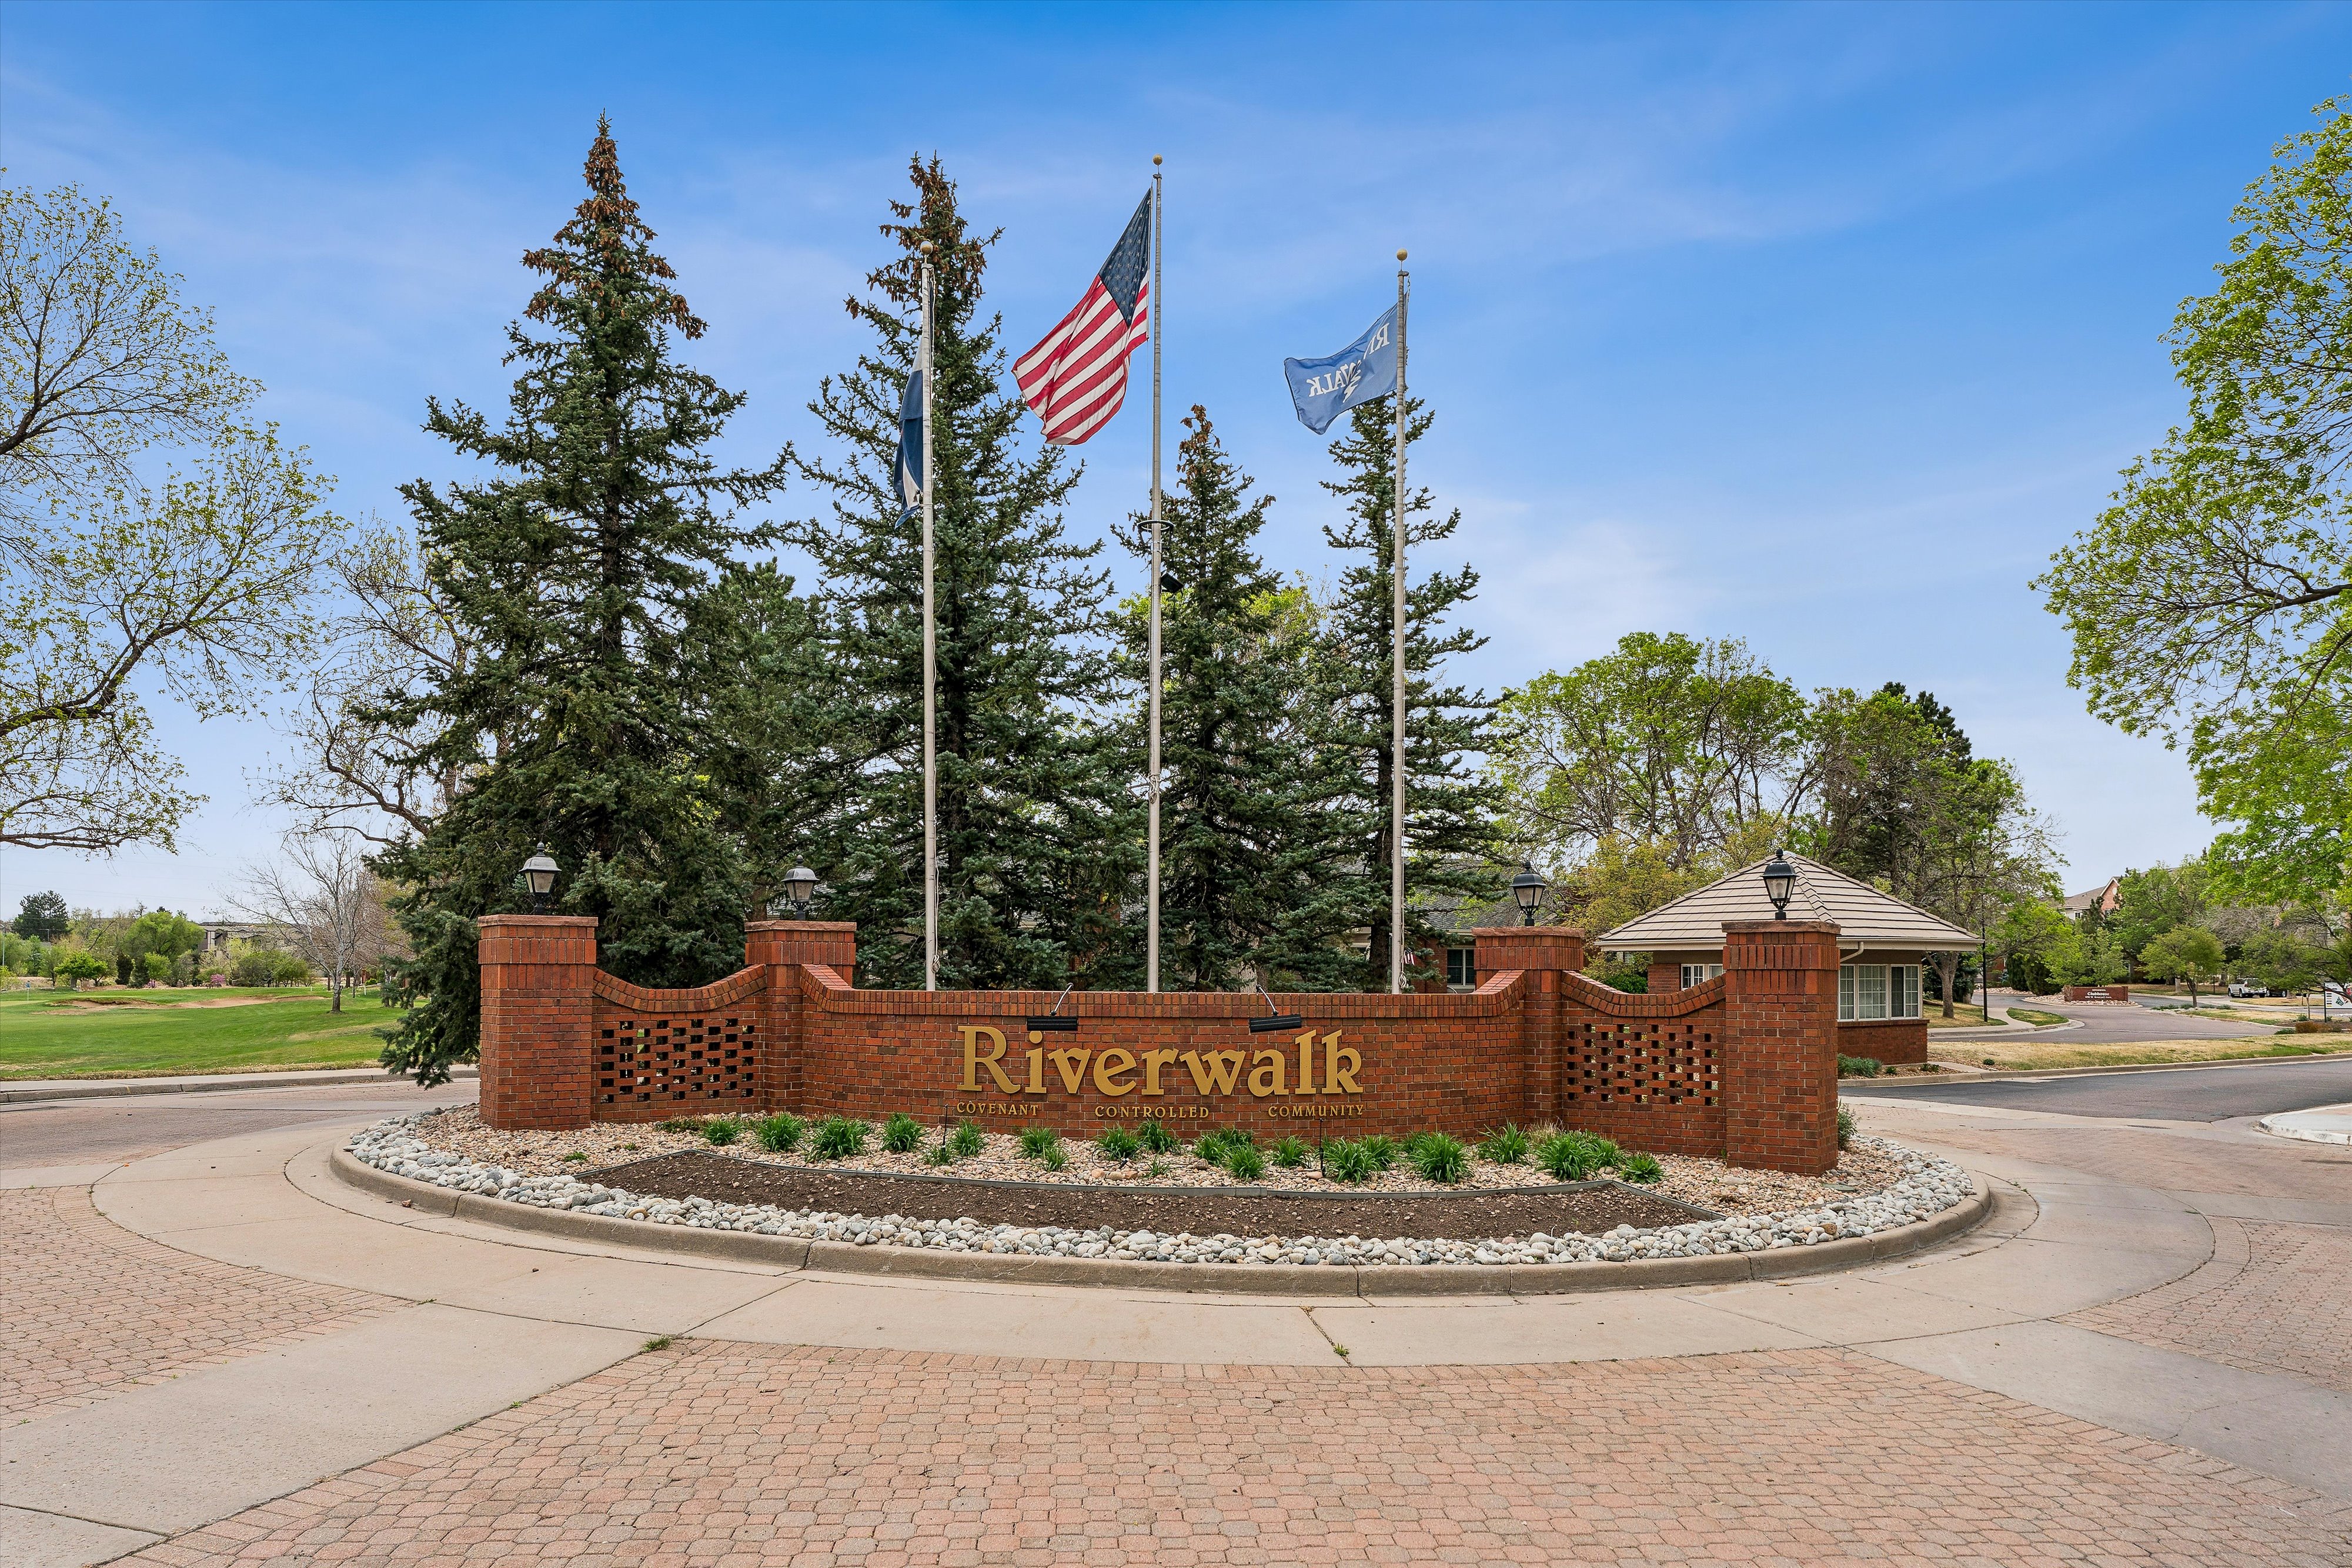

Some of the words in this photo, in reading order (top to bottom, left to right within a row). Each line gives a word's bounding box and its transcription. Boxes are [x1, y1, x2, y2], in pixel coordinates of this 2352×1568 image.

[957, 1025, 1364, 1097] Riverwalk
[956, 1102, 1038, 1116] COVENANT
[1094, 1105, 1210, 1119] CONTROLLED
[1268, 1104, 1364, 1118] COMMUNITY
